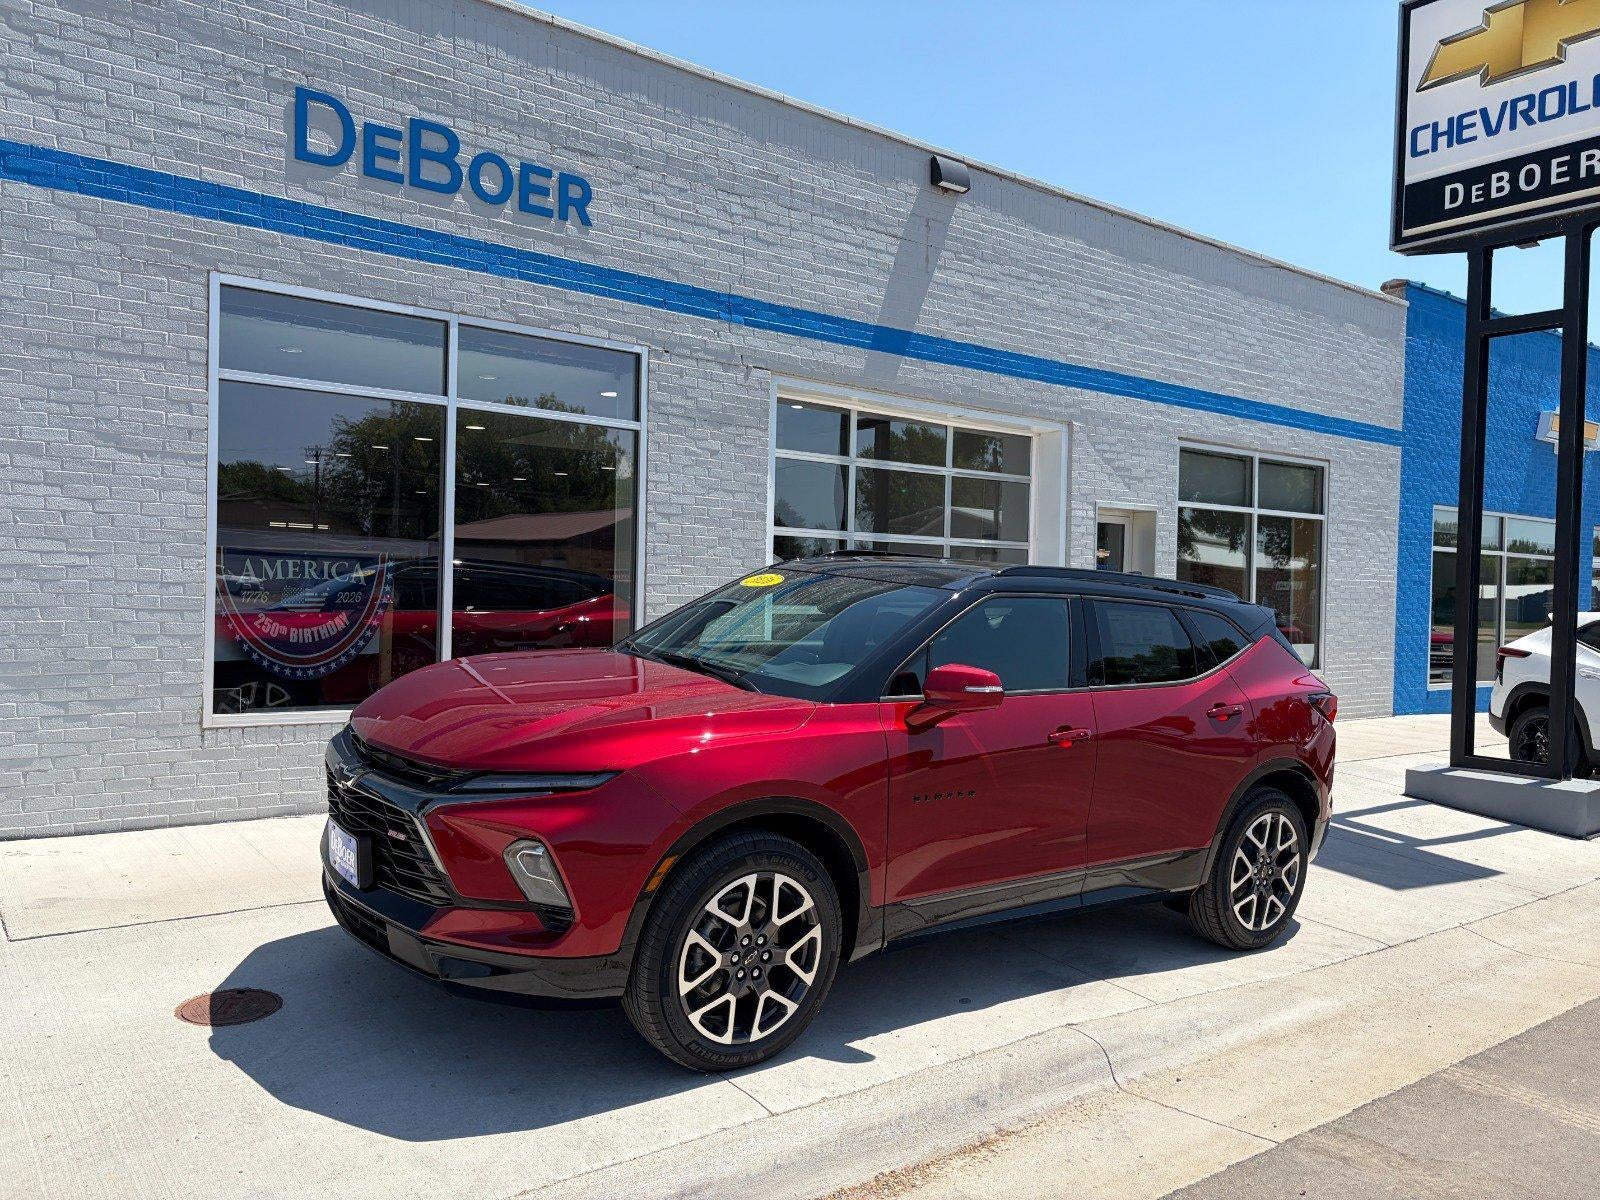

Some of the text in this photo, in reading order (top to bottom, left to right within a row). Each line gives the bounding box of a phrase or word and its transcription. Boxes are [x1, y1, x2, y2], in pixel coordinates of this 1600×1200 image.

[238, 558, 367, 585] AMERICA
[241, 590, 362, 603] 1776 2026
[253, 611, 350, 643] 250th BIRTHDAY
